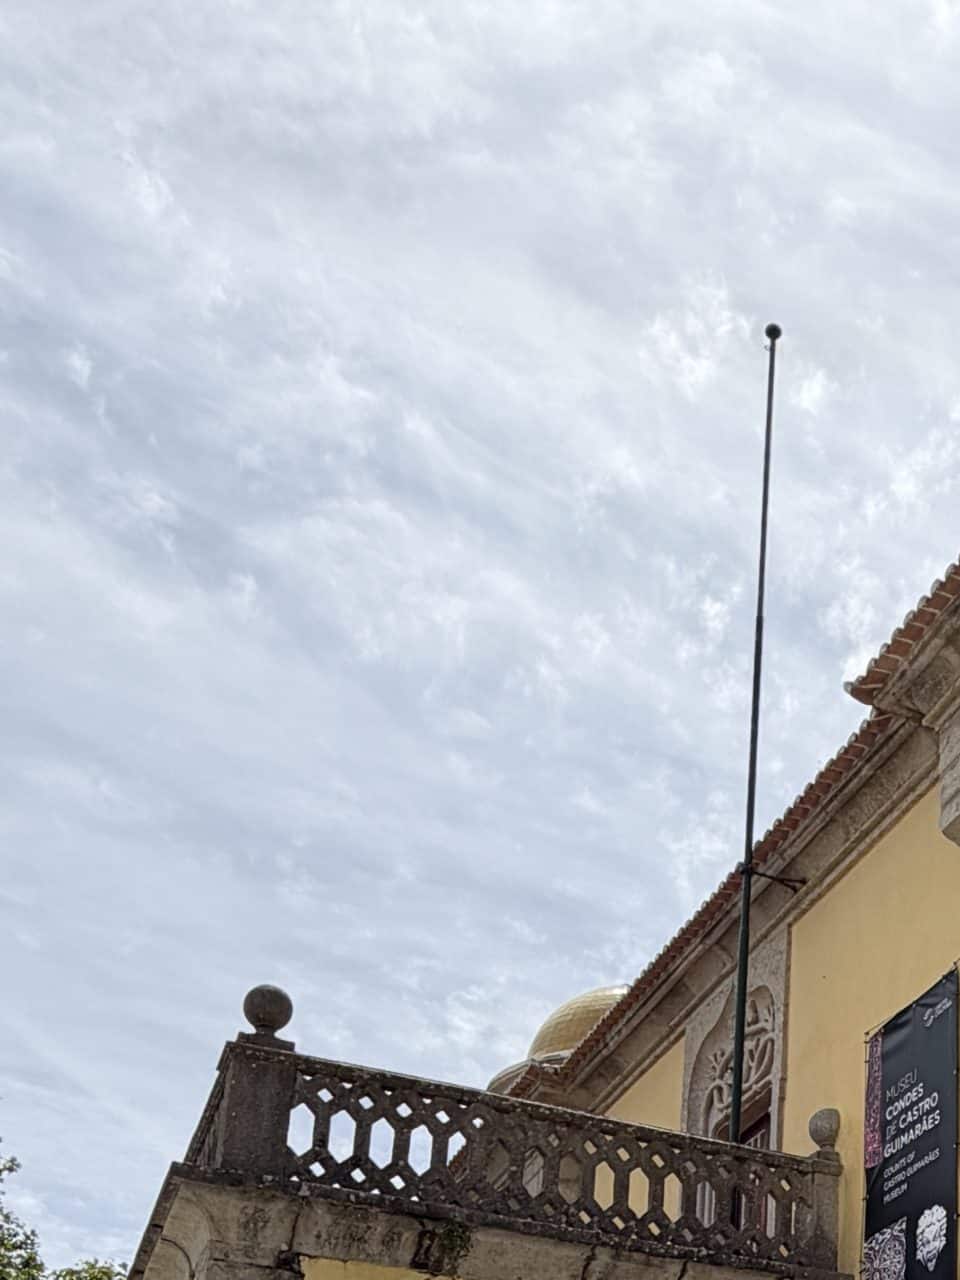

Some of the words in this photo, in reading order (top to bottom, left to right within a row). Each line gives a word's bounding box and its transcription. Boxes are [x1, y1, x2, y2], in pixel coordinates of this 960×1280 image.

[886, 1067, 917, 1102] MUSEU
[886, 1082, 923, 1120] CONDES
[884, 1110, 940, 1157] GUIMARÃES
[886, 1119, 898, 1141] DE
[899, 1092, 939, 1128] CASTRO
[883, 1171, 906, 1191] CASTRO
[884, 1157, 906, 1178] COUNTS
